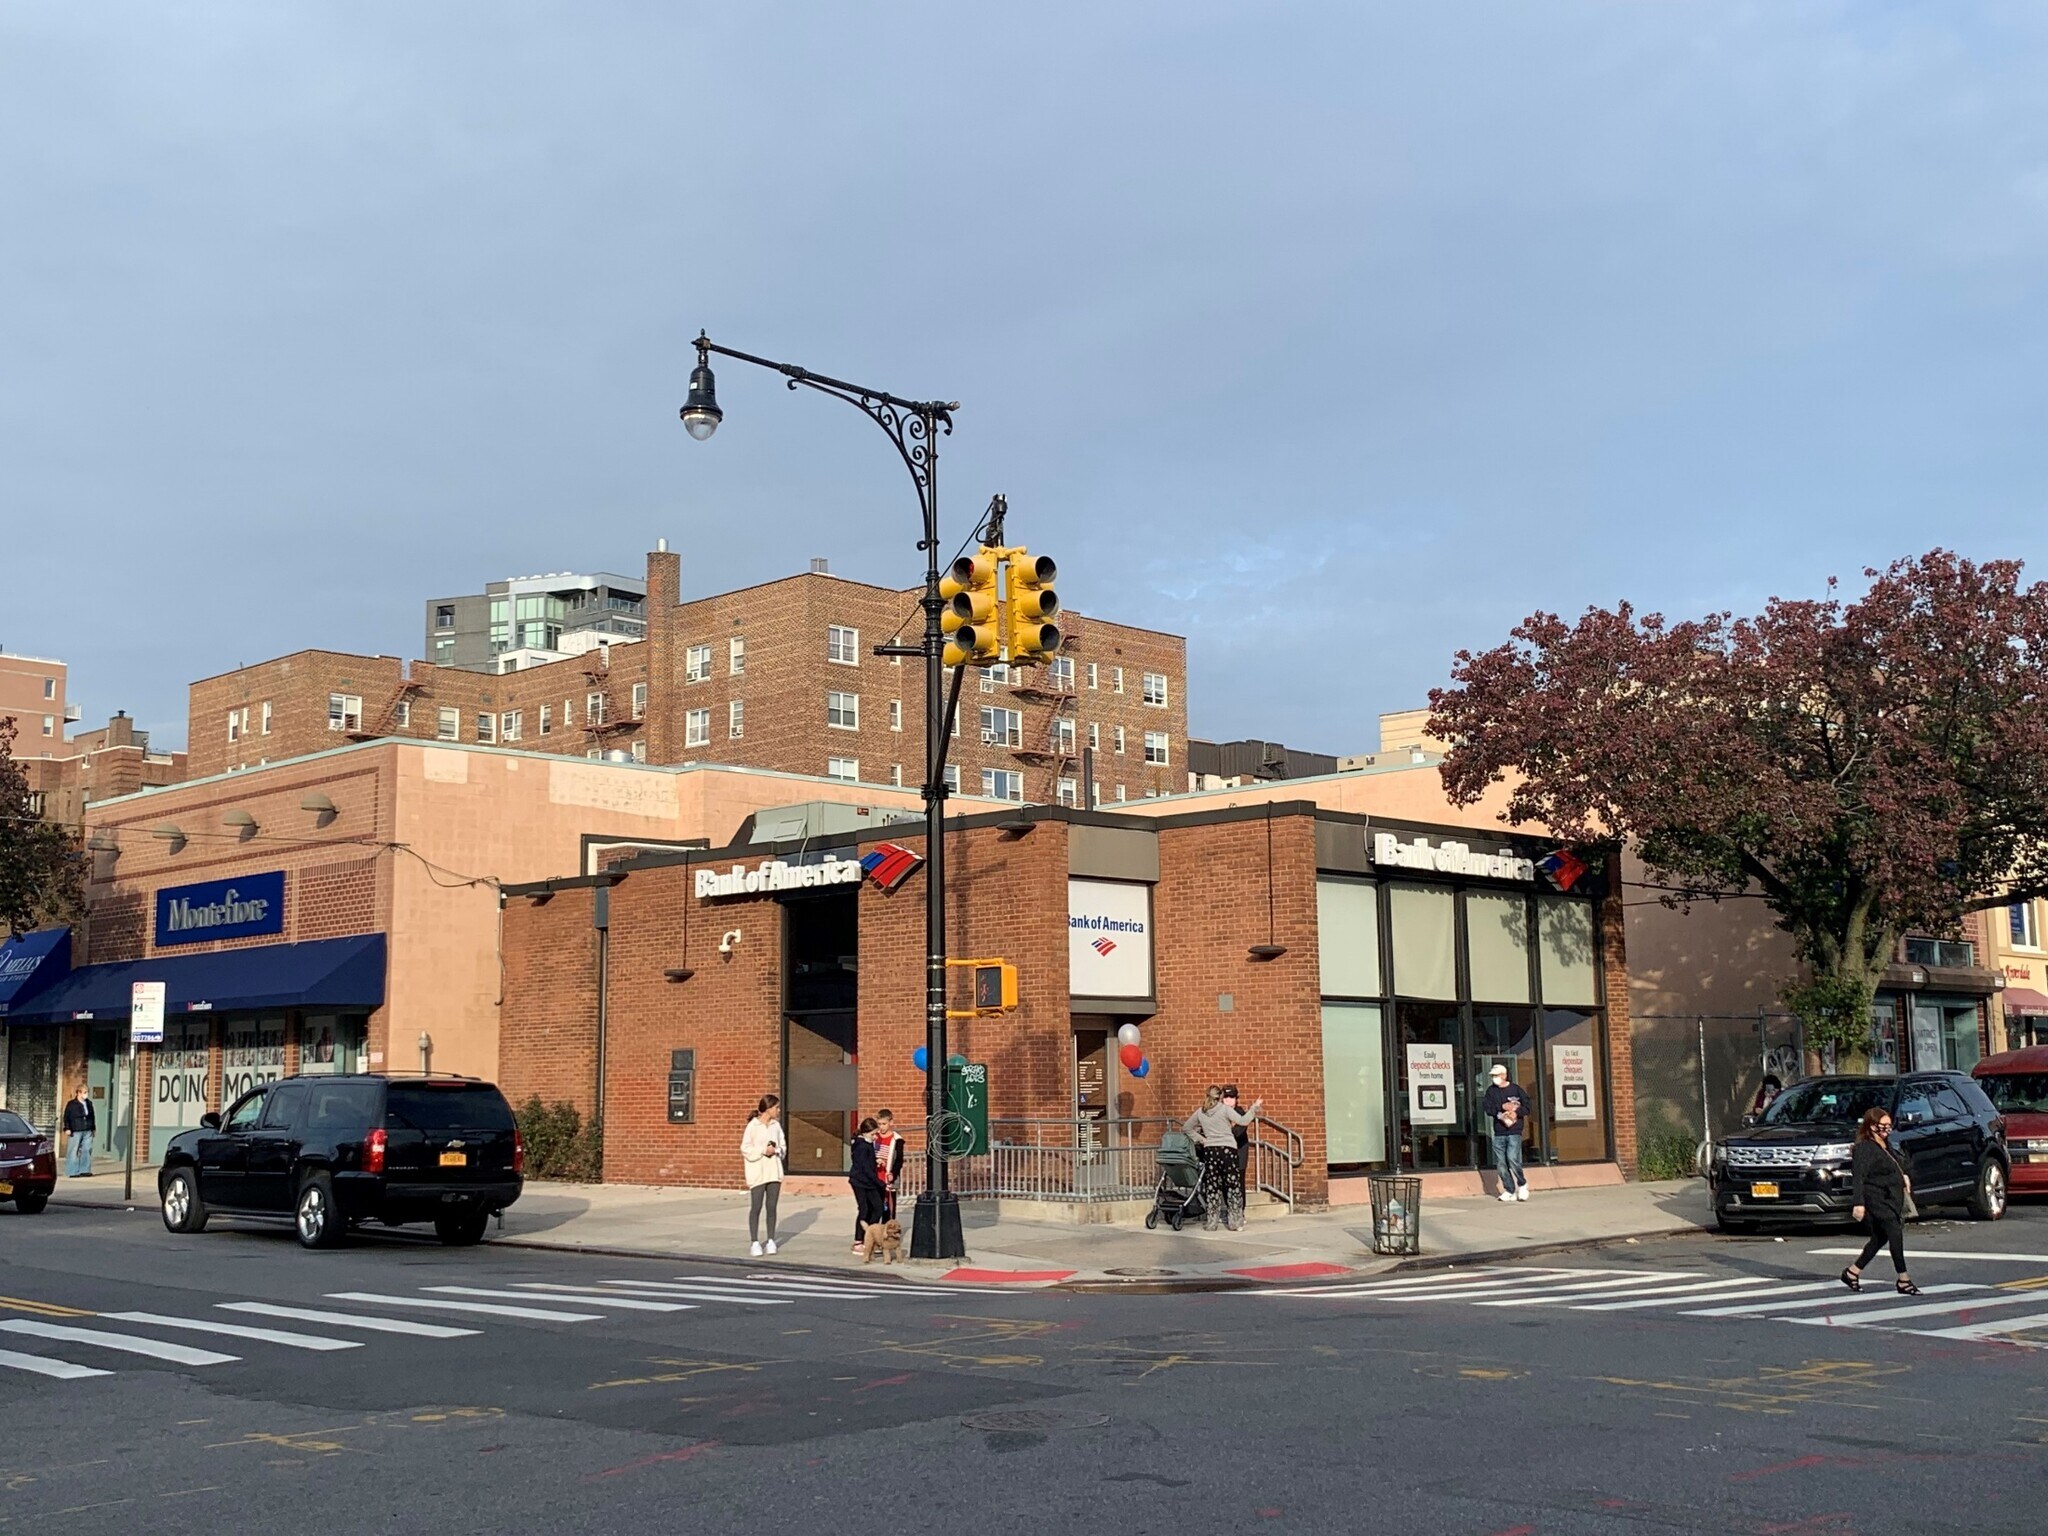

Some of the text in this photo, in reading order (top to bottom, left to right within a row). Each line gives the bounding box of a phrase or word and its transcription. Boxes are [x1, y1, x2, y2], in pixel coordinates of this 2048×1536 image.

[1375, 833, 1534, 881] Bank of America
[695, 853, 862, 898] Bank of America
[167, 888, 270, 931] Montefiore
[1091, 915, 1102, 929] of
[1102, 916, 1144, 933] America
[1424, 1051, 1437, 1060] Easily
[1410, 1061, 1451, 1072] deposit checks
[1419, 1071, 1444, 1080] from home
